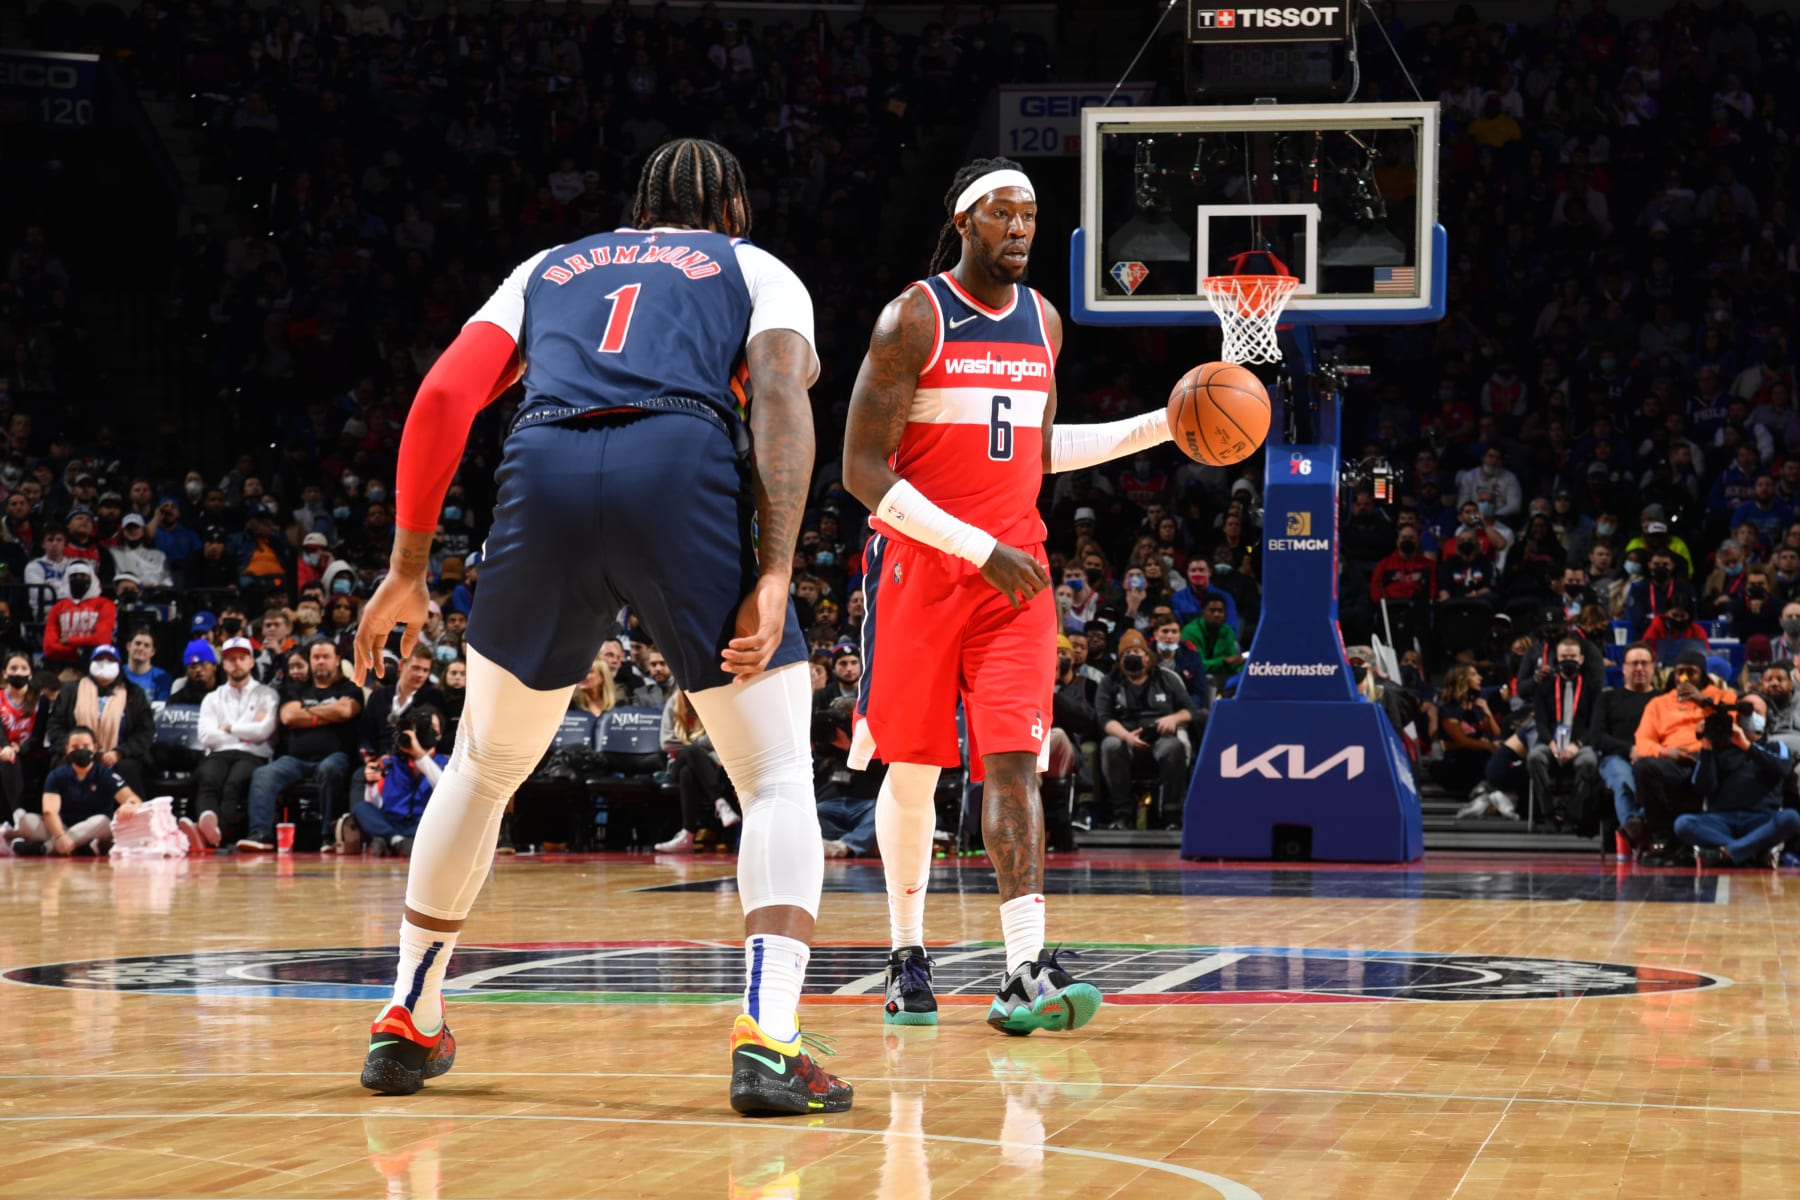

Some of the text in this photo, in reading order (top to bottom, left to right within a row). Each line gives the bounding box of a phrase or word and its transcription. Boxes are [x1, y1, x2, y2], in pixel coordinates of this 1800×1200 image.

[1237, 7, 1339, 27] TISSOT
[40, 97, 94, 126] 120
[1009, 127, 1058, 151] 120
[542, 245, 721, 286] DRUMMOND
[598, 282, 642, 354] 1
[945, 351, 1047, 382] washington
[989, 394, 1013, 461] 6
[1289, 458, 1312, 475] 76
[1268, 539, 1329, 551] BETMGM
[1248, 661, 1338, 676] ticketmaster
[162, 710, 190, 724] NJM
[611, 713, 640, 726] NJM
[1220, 744, 1365, 780] KIA
